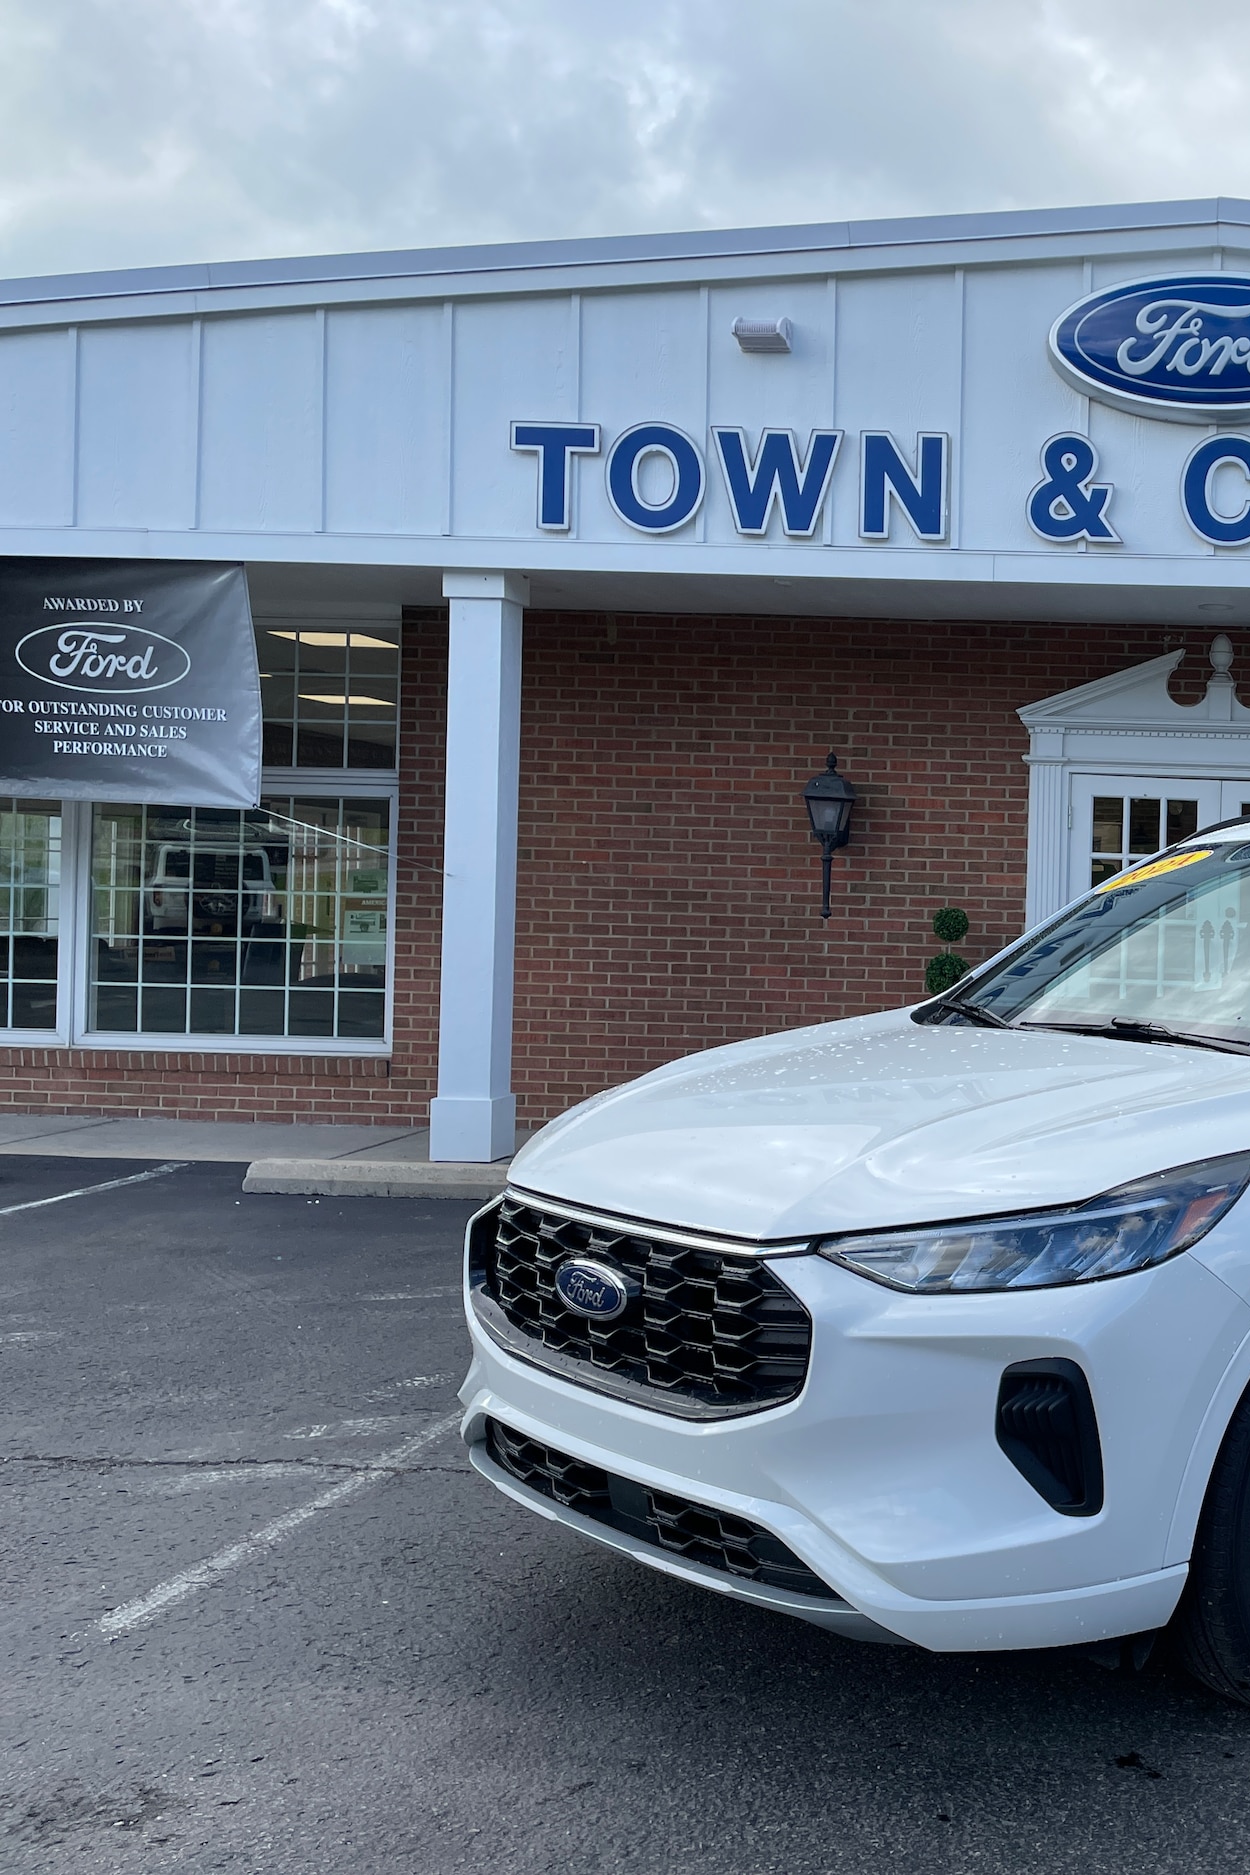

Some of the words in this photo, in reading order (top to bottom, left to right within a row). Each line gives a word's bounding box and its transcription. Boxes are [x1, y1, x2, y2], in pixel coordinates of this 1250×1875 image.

[509, 420, 949, 541] TOWN
[1026, 432, 1124, 544] &
[43, 597, 119, 612] AWARDED
[123, 600, 144, 613] BY
[49, 630, 158, 679] Ford
[28, 701, 138, 718] OUTSTANDING
[142, 705, 228, 722] CUSTOMER
[34, 720, 100, 736] SERVICE
[104, 723, 136, 737] AND
[140, 725, 188, 739] SALES
[53, 741, 168, 758] PERFORMANCE
[566, 1270, 605, 1308] Ford
